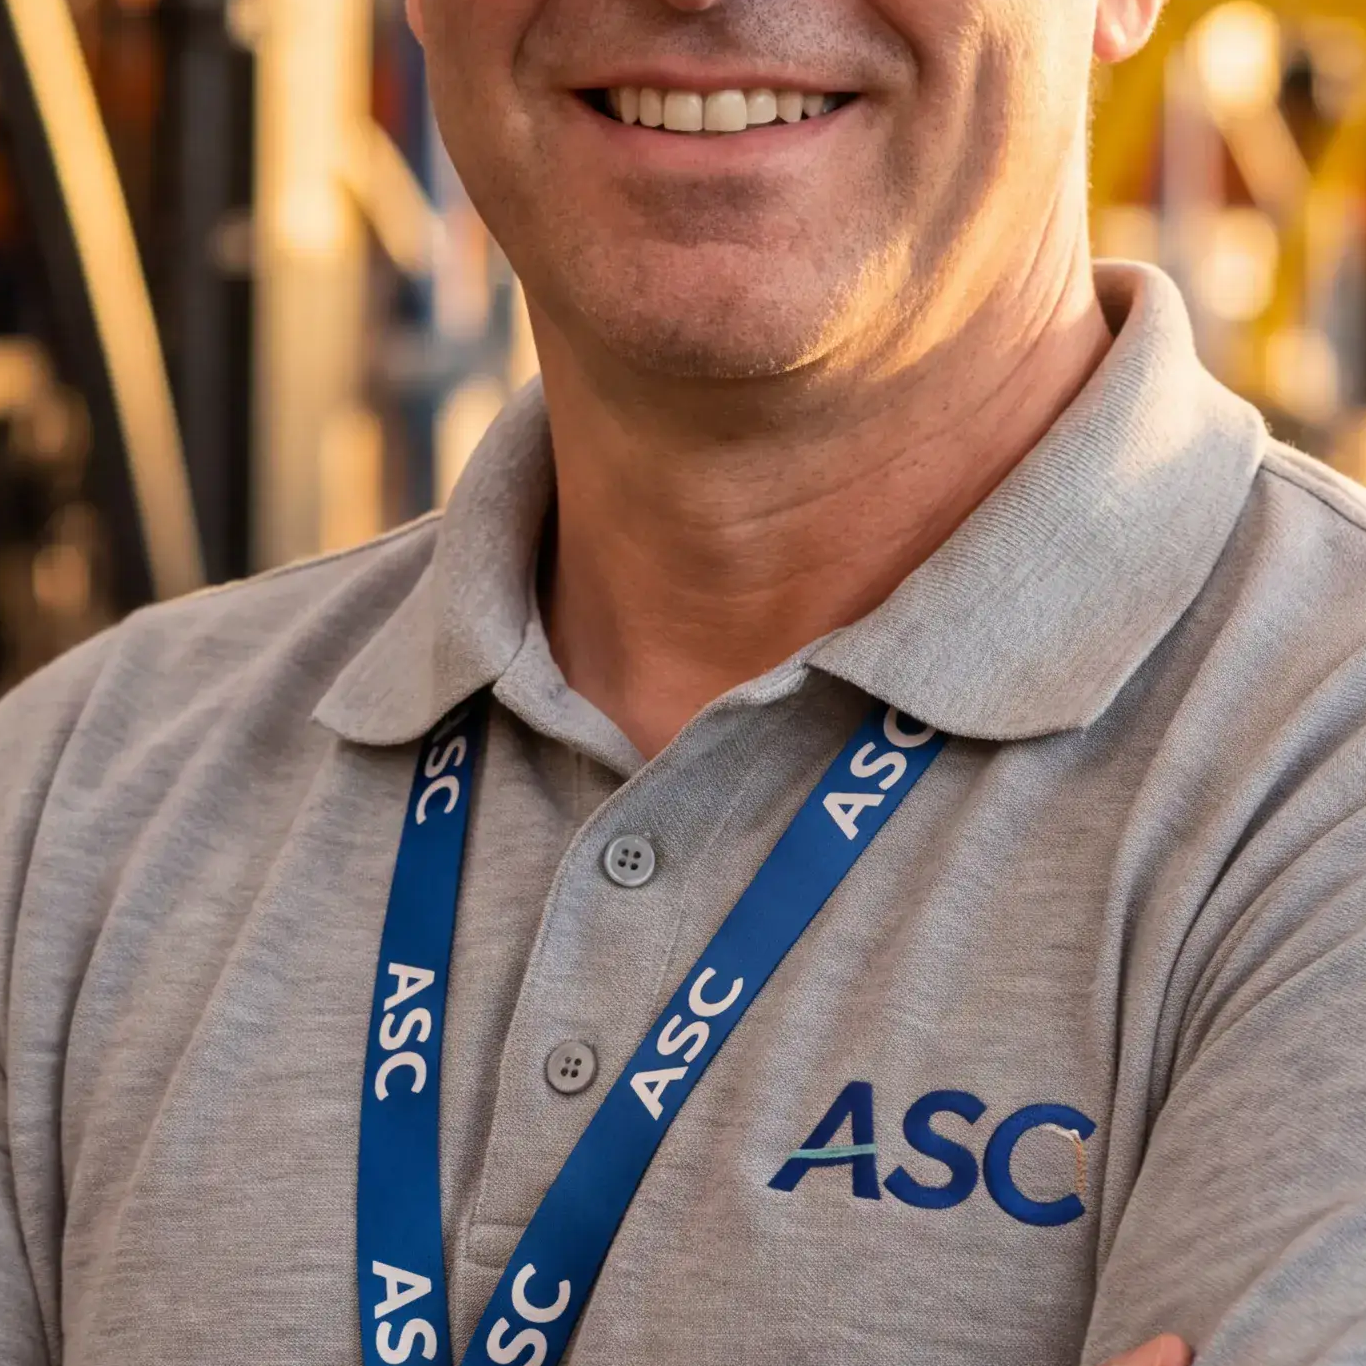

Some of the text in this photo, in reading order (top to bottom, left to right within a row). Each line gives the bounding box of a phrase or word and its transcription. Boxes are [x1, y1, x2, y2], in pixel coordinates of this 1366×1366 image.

[374, 962, 435, 1101] ASC
[629, 967, 744, 1120] ASC
[768, 1081, 1096, 1226] ASC
